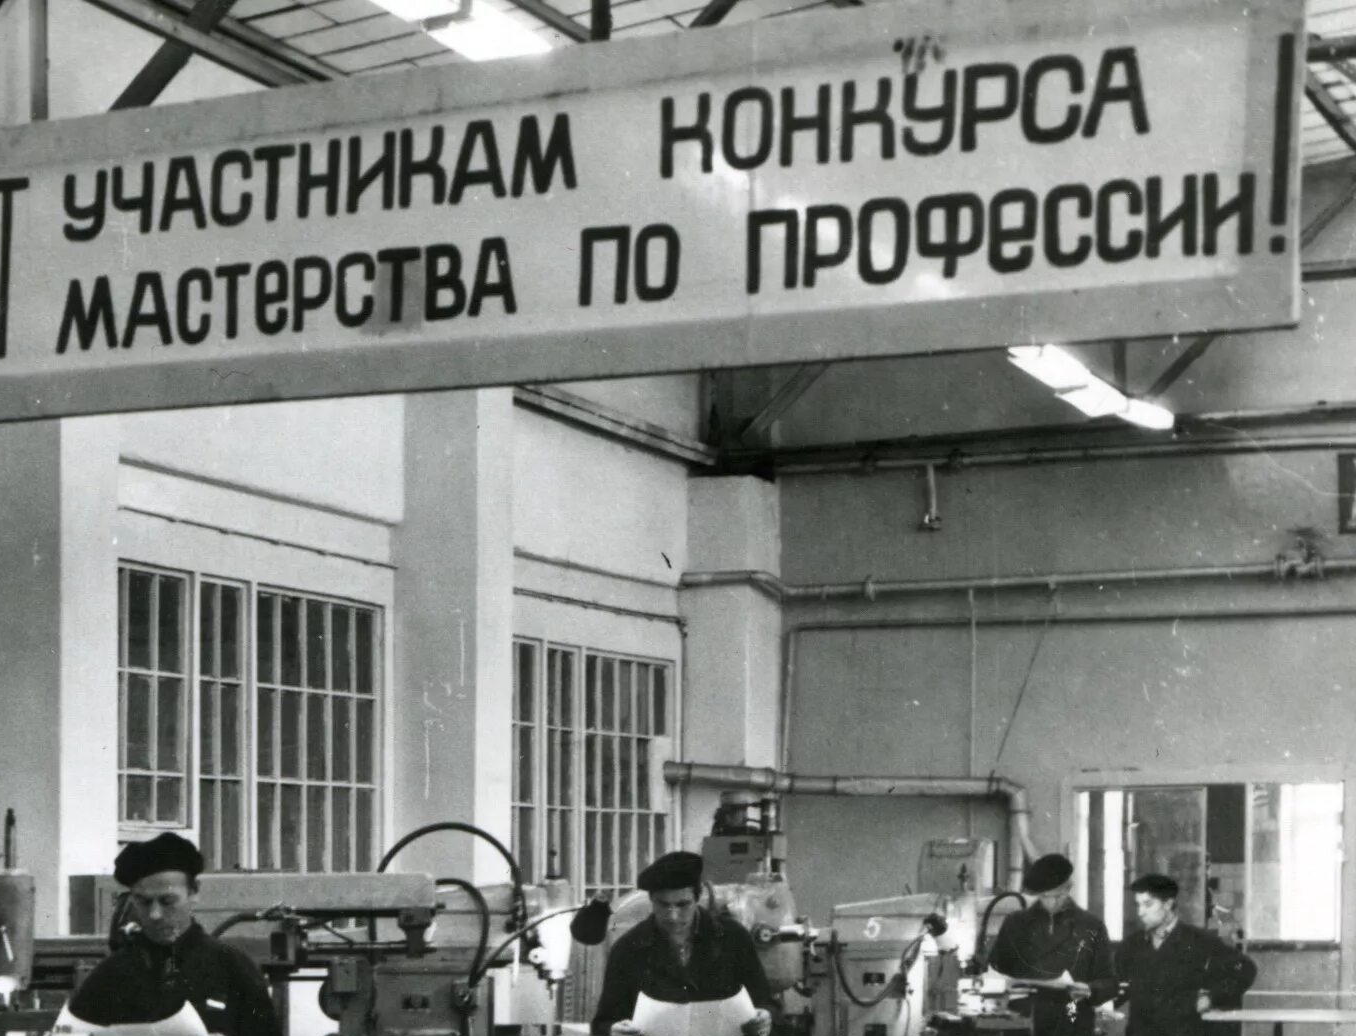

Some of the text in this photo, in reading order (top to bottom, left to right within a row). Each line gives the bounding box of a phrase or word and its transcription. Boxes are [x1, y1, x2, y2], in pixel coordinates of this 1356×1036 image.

[63, 47, 1149, 242] УЧАСТНИКАМ КОНКУРСА
[56, 237, 517, 354] МАСТЕРСТВА
[579, 224, 680, 307] ПО
